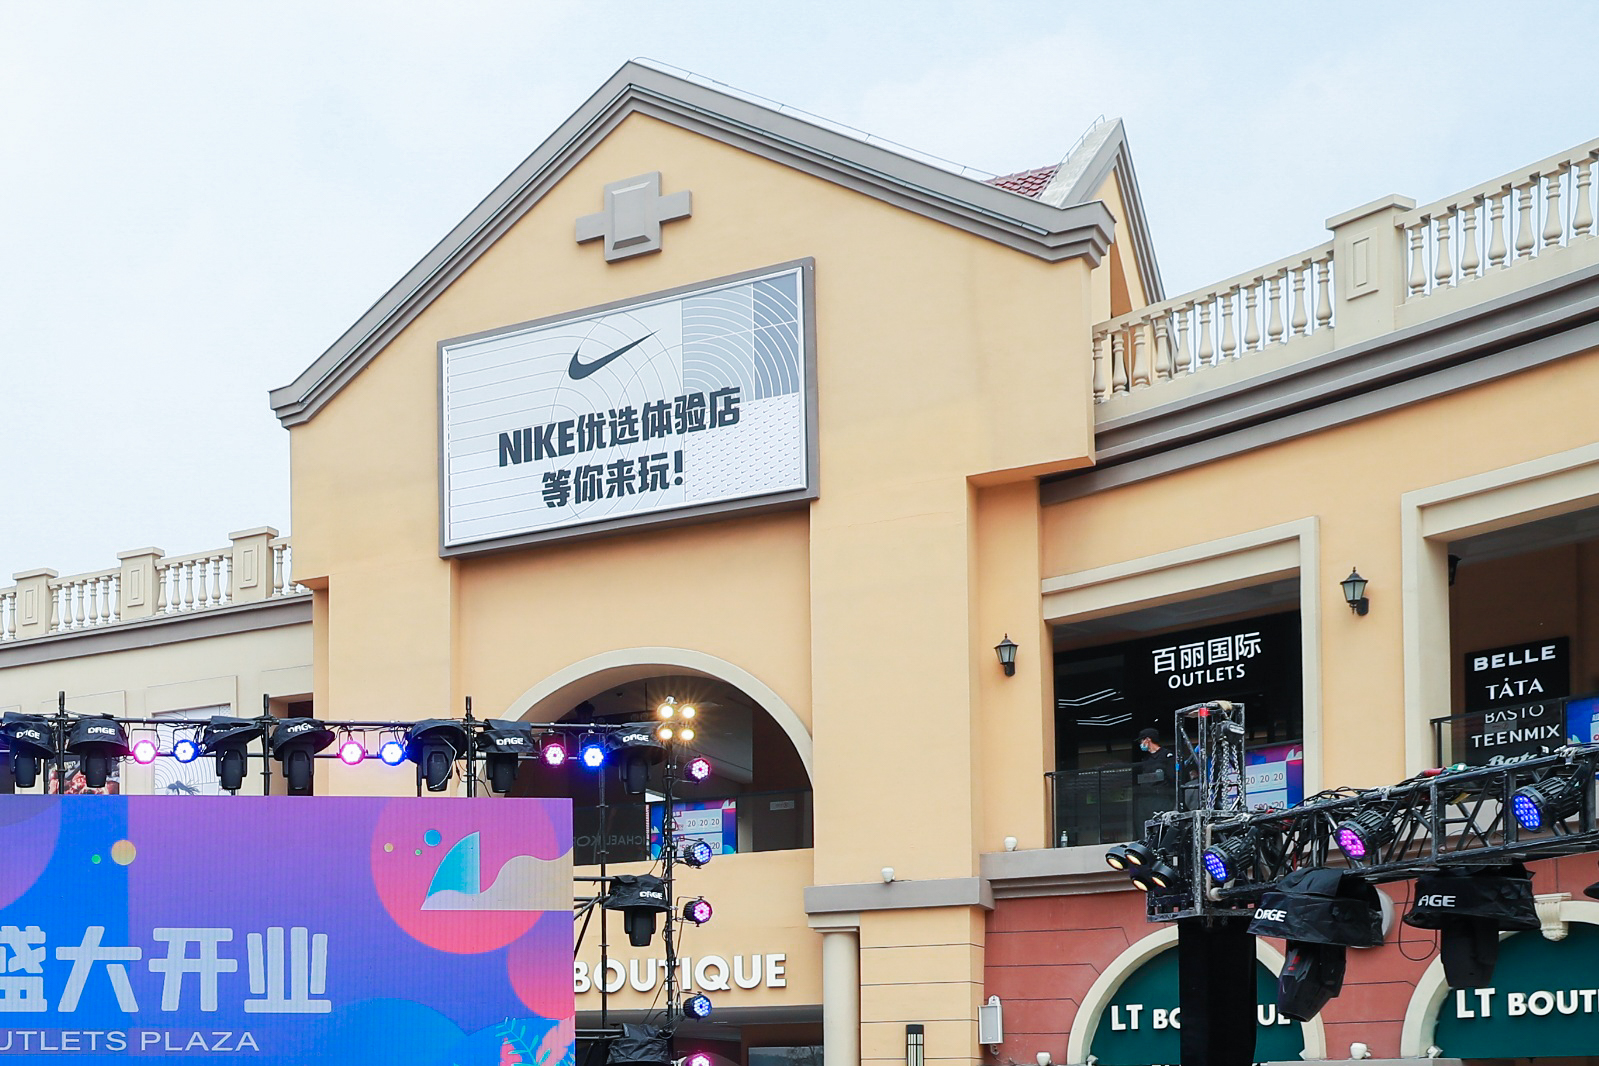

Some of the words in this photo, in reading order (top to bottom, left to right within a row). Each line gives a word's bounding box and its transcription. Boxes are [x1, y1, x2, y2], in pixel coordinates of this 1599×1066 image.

[498, 387, 741, 467] NIKE优选体验店
[1152, 631, 1262, 674] 百丽国际
[1473, 645, 1556, 672] BELLE
[1168, 663, 1245, 689] OUTLETS
[1471, 724, 1560, 748] TEENMIX
[574, 952, 787, 994] BOUTIQUE
[1111, 1003, 1144, 1031] LT
[1456, 987, 1496, 1019] LT
[1508, 989, 1599, 1016] BOUT
[141, 1030, 260, 1052] PLAZA
